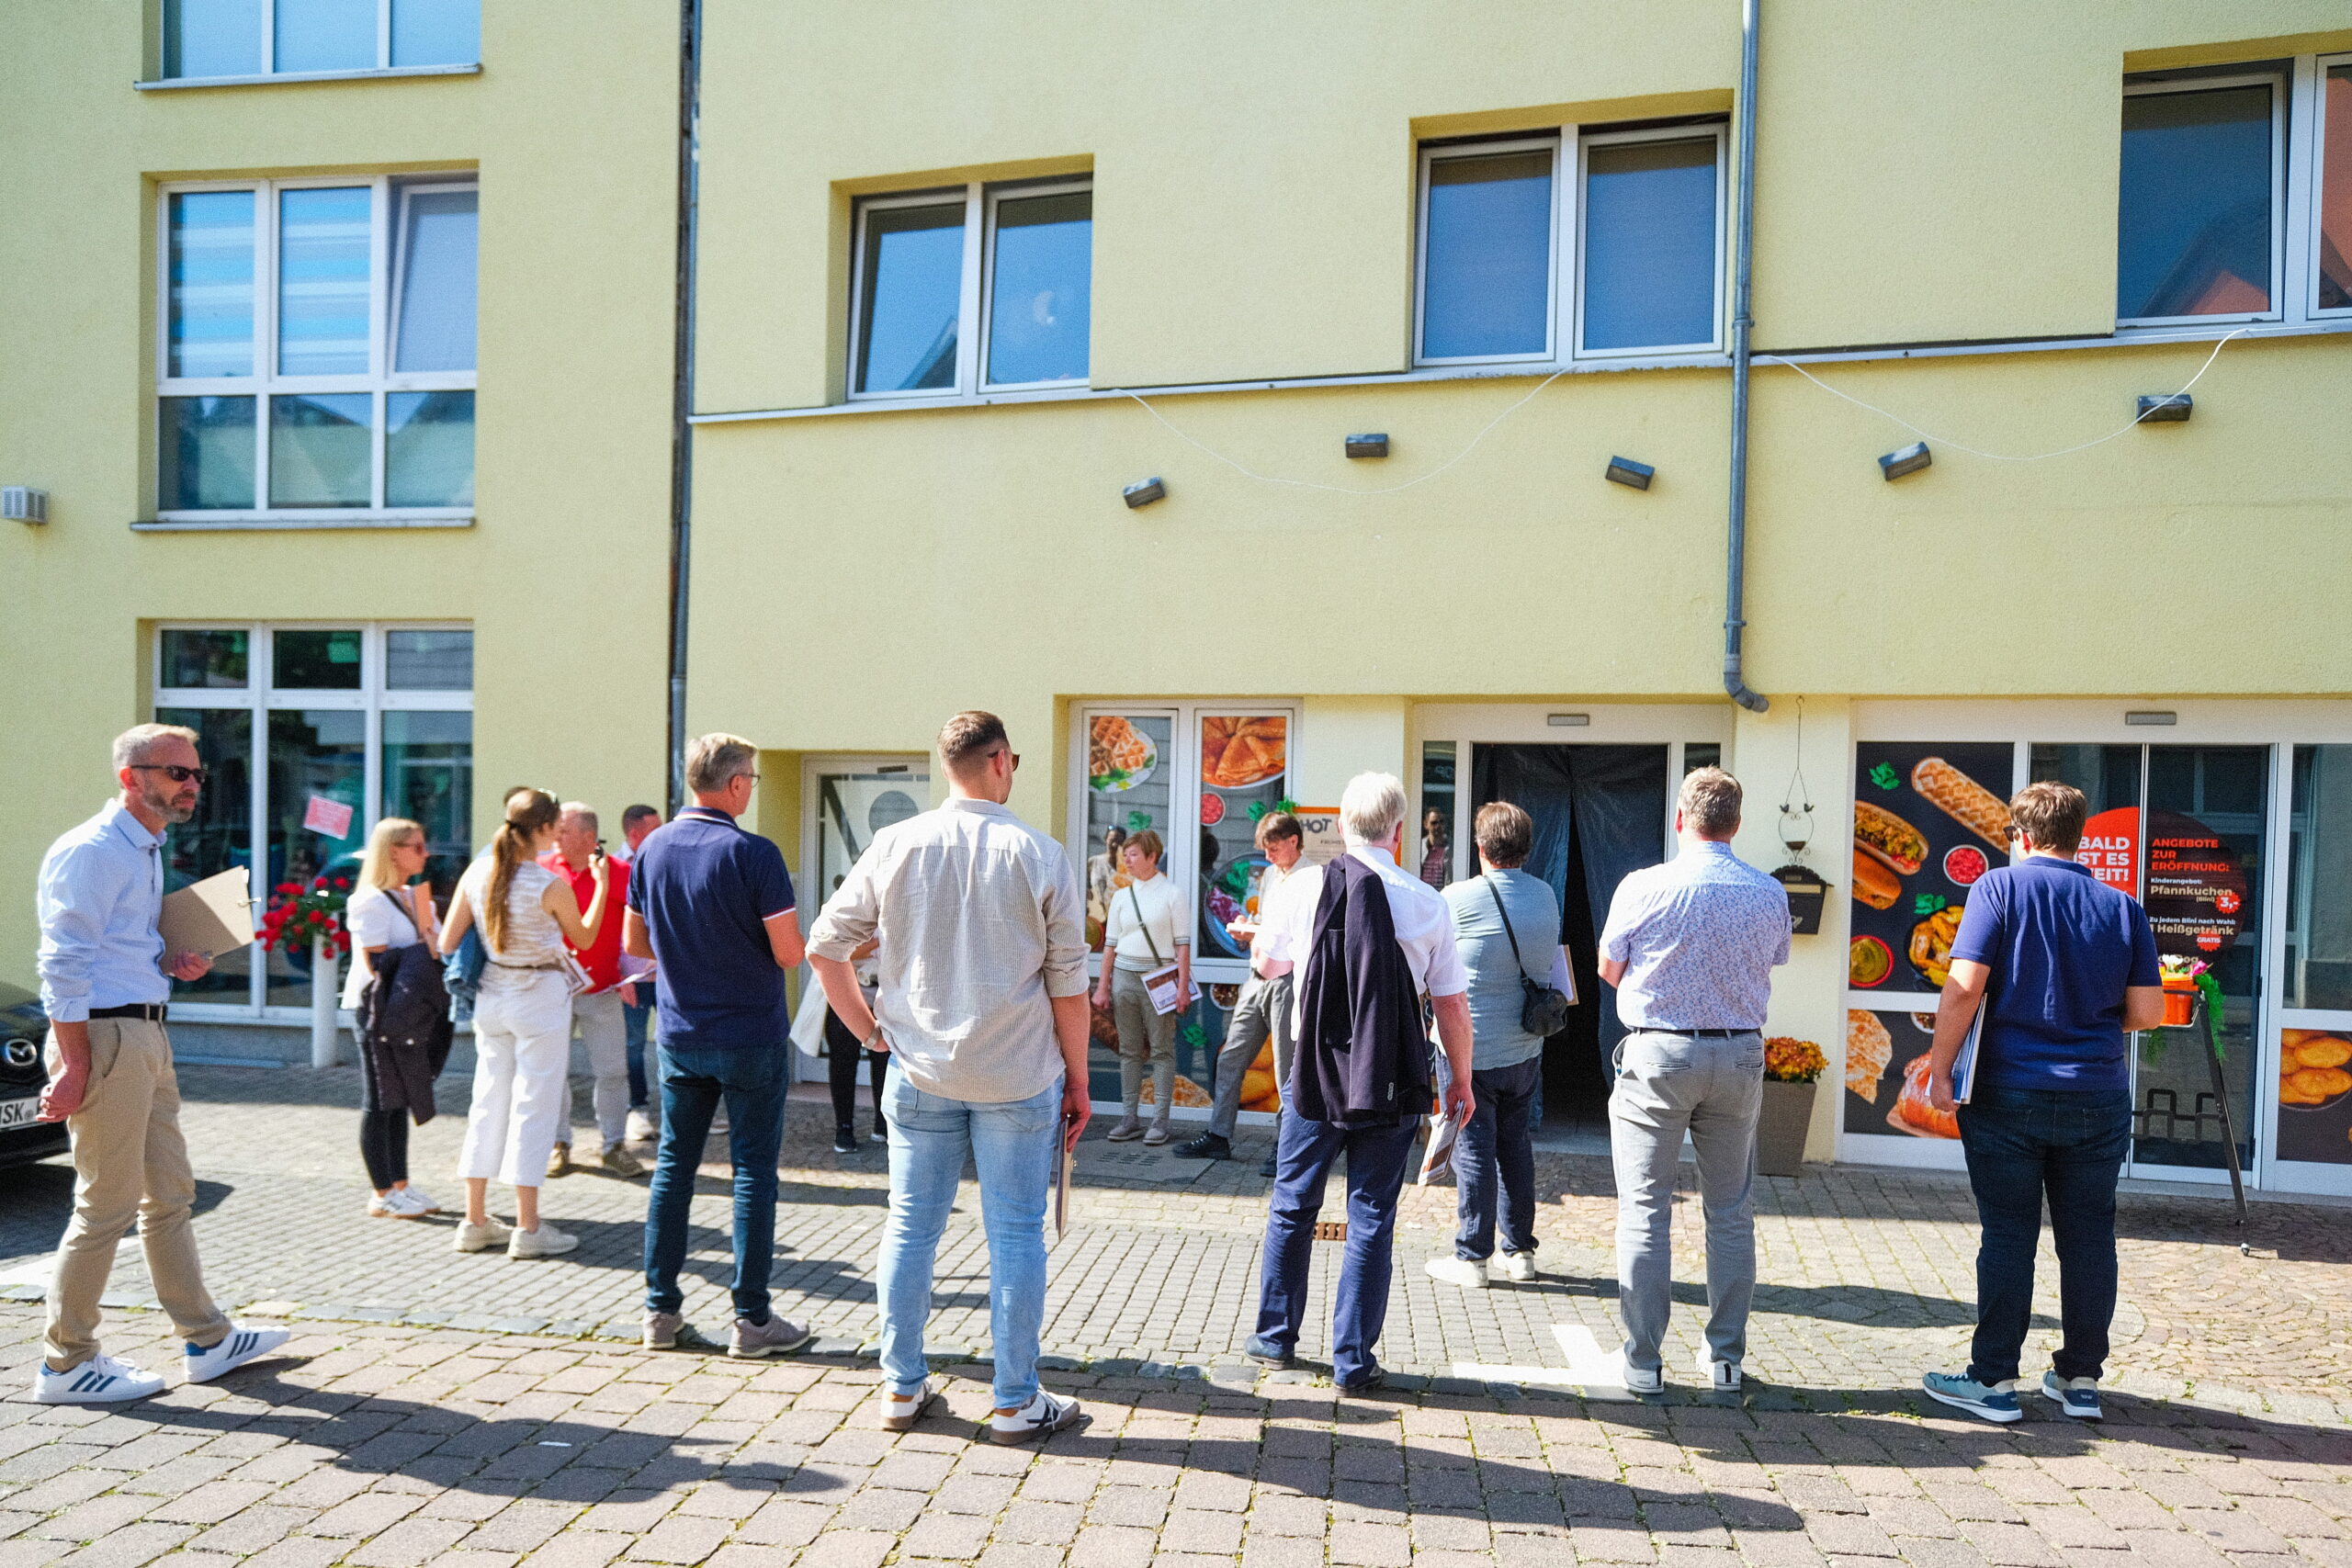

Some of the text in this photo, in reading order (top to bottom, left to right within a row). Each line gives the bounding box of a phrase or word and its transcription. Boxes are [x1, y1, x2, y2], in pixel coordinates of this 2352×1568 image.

[1300, 818, 1331, 833] HOT
[2078, 836, 2130, 850] BALD
[2152, 839, 2219, 848] ANGEBOTE
[2106, 852, 2130, 866] ES
[2151, 850, 2177, 860] ZUR
[2152, 860, 2230, 872] ERÖFFNUNG:
[2090, 867, 2130, 882] EIT!
[2150, 885, 2233, 897] Pfannkuchen
[2220, 897, 2239, 909] 3,-
[2159, 916, 2180, 924] jedem
[2157, 923, 2233, 935] Heißgetränk
